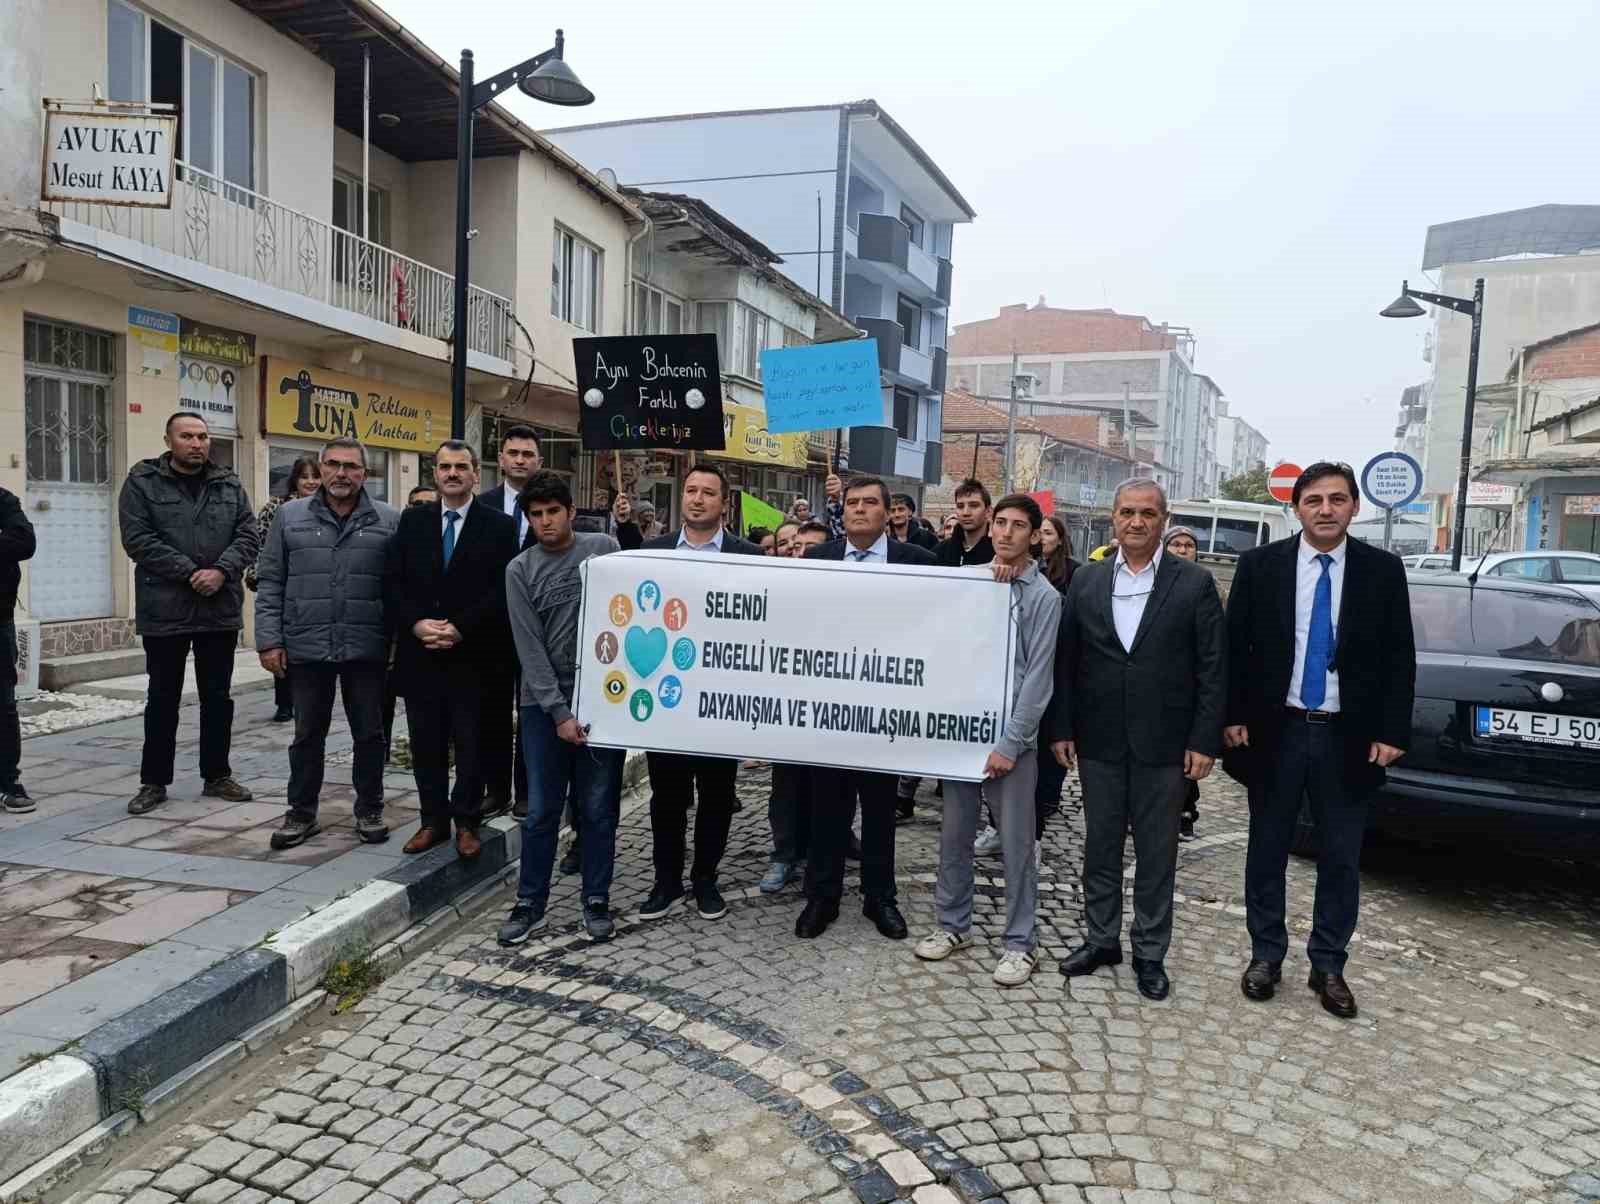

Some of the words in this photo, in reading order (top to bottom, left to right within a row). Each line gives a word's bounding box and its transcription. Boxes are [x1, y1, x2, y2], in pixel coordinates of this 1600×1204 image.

[56, 126, 163, 155] AVUKAT
[50, 162, 103, 190] Mesut
[112, 166, 165, 193] KAYA
[594, 351, 629, 390] Aynı
[314, 387, 352, 405] MATBAA
[366, 392, 418, 419] Reklam
[638, 386, 677, 409] Farklı
[365, 419, 417, 441] Matbaa
[705, 588, 768, 622] SELENDİ
[702, 638, 765, 673] ENGELLİ
[769, 646, 789, 675] VE
[792, 646, 857, 681] ENGELLİ
[860, 648, 925, 687] AİLELER
[698, 691, 783, 731] DAYANIŞMA
[787, 699, 808, 728] VE
[812, 701, 922, 744] YARDIMLAŞMA
[926, 710, 997, 744] DERNEĞİ
[1492, 711, 1519, 733] 54
[1531, 714, 1559, 737] EJ
